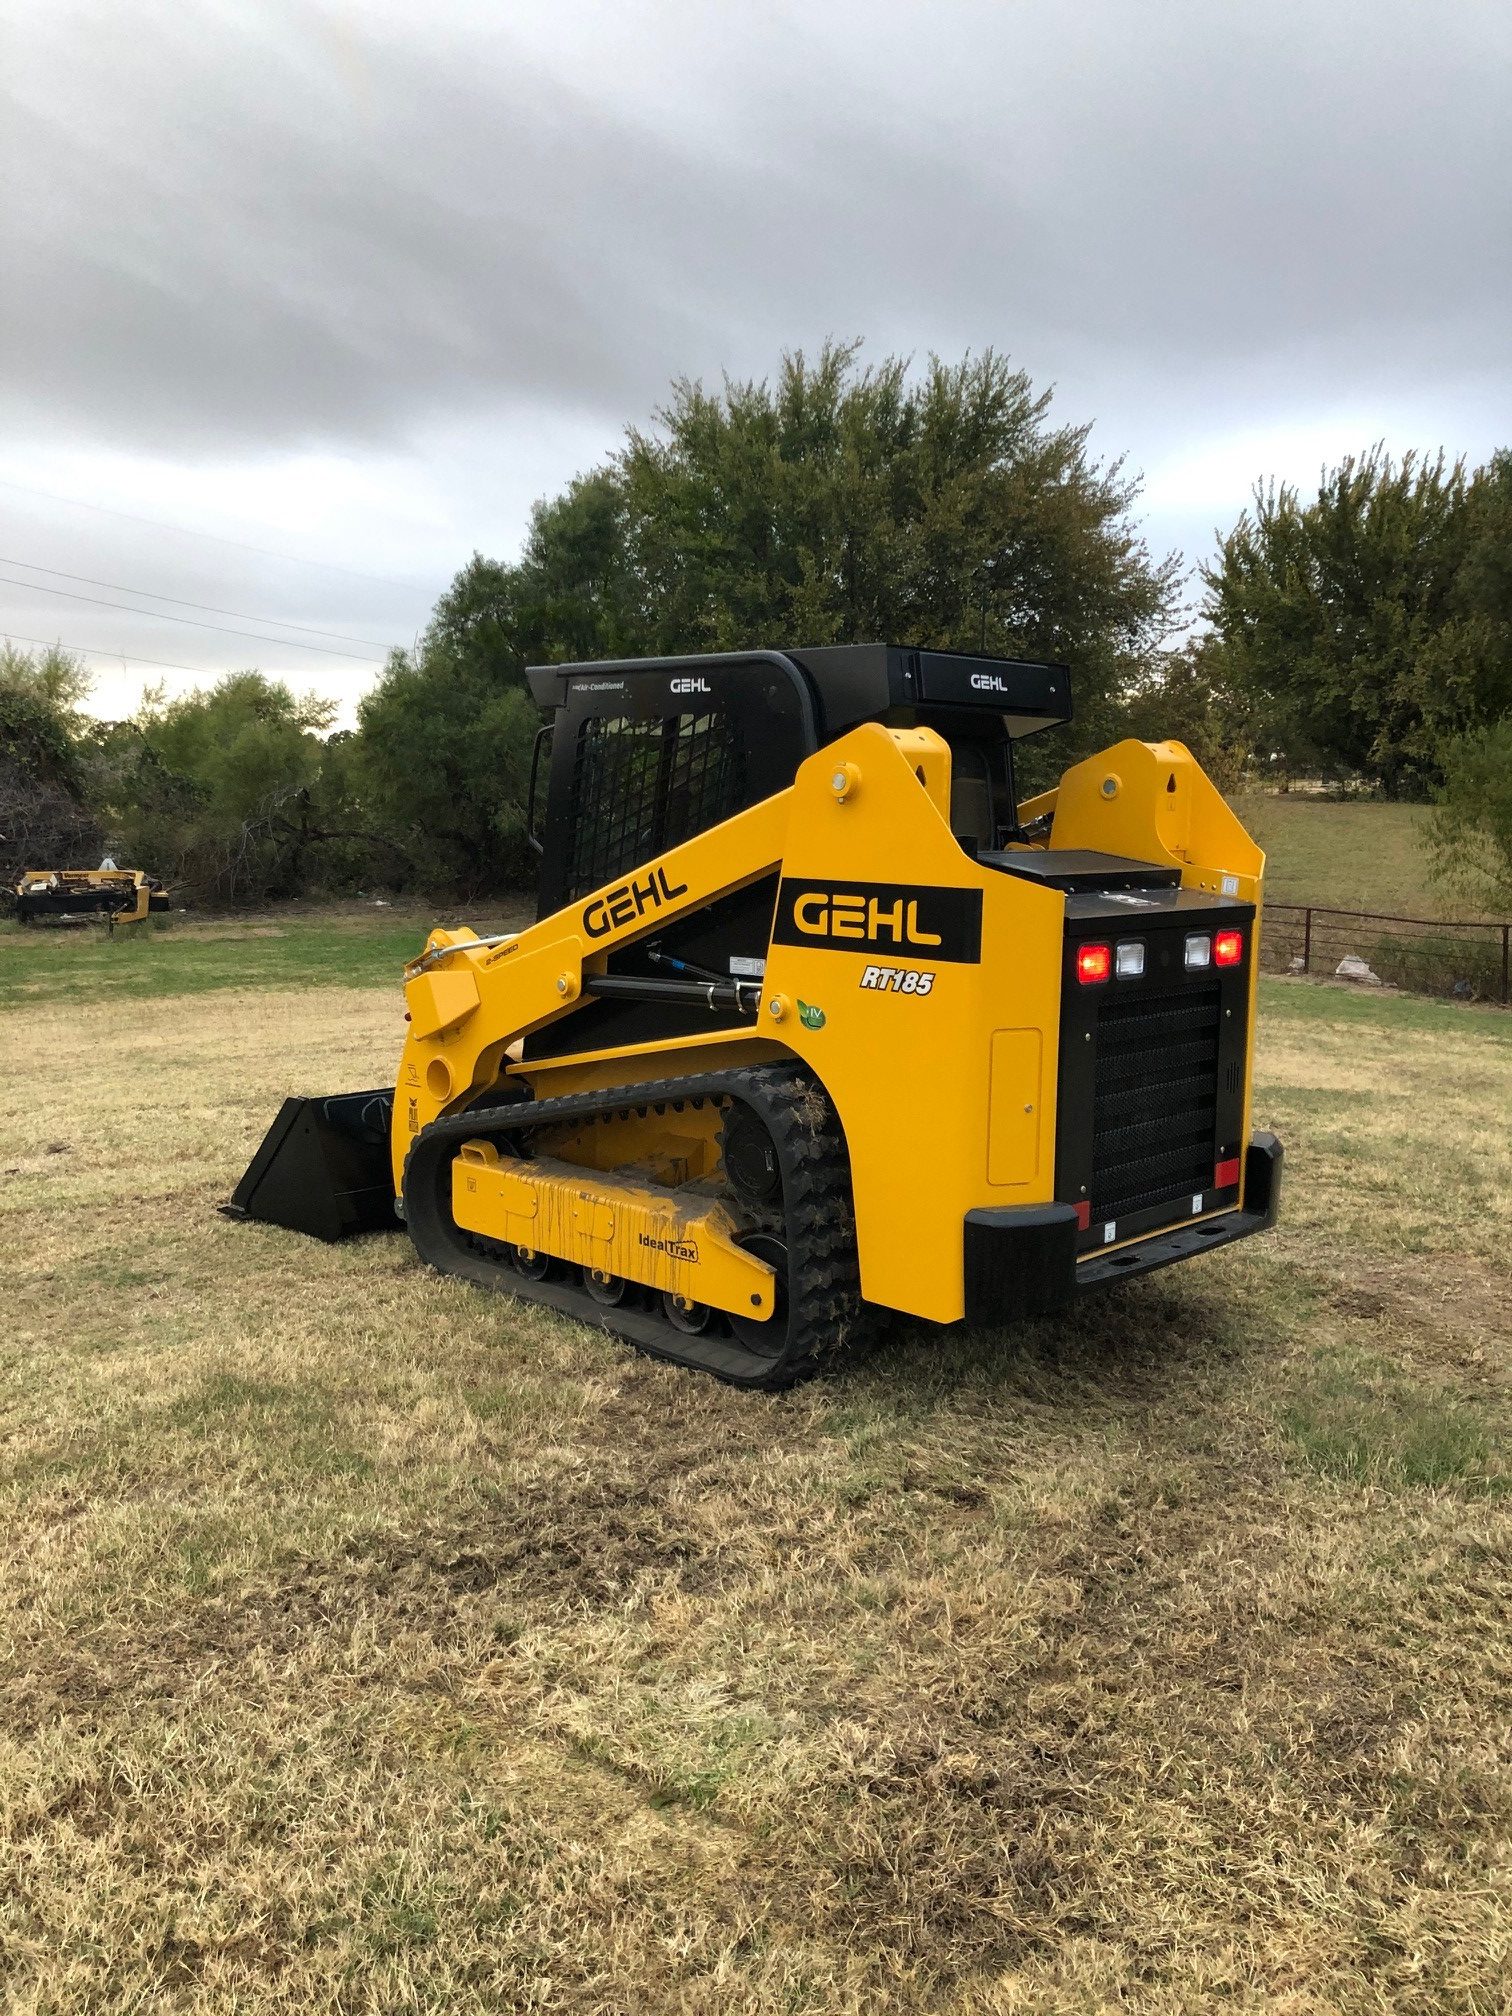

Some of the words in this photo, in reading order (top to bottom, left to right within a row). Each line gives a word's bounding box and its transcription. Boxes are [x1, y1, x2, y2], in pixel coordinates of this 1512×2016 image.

[670, 678, 711, 693] GEHL
[970, 673, 1008, 692] GEHL
[582, 866, 688, 939] GEHL
[793, 892, 942, 946] GEHL
[859, 965, 936, 996] RT185
[638, 1232, 697, 1261] IdealTrax
